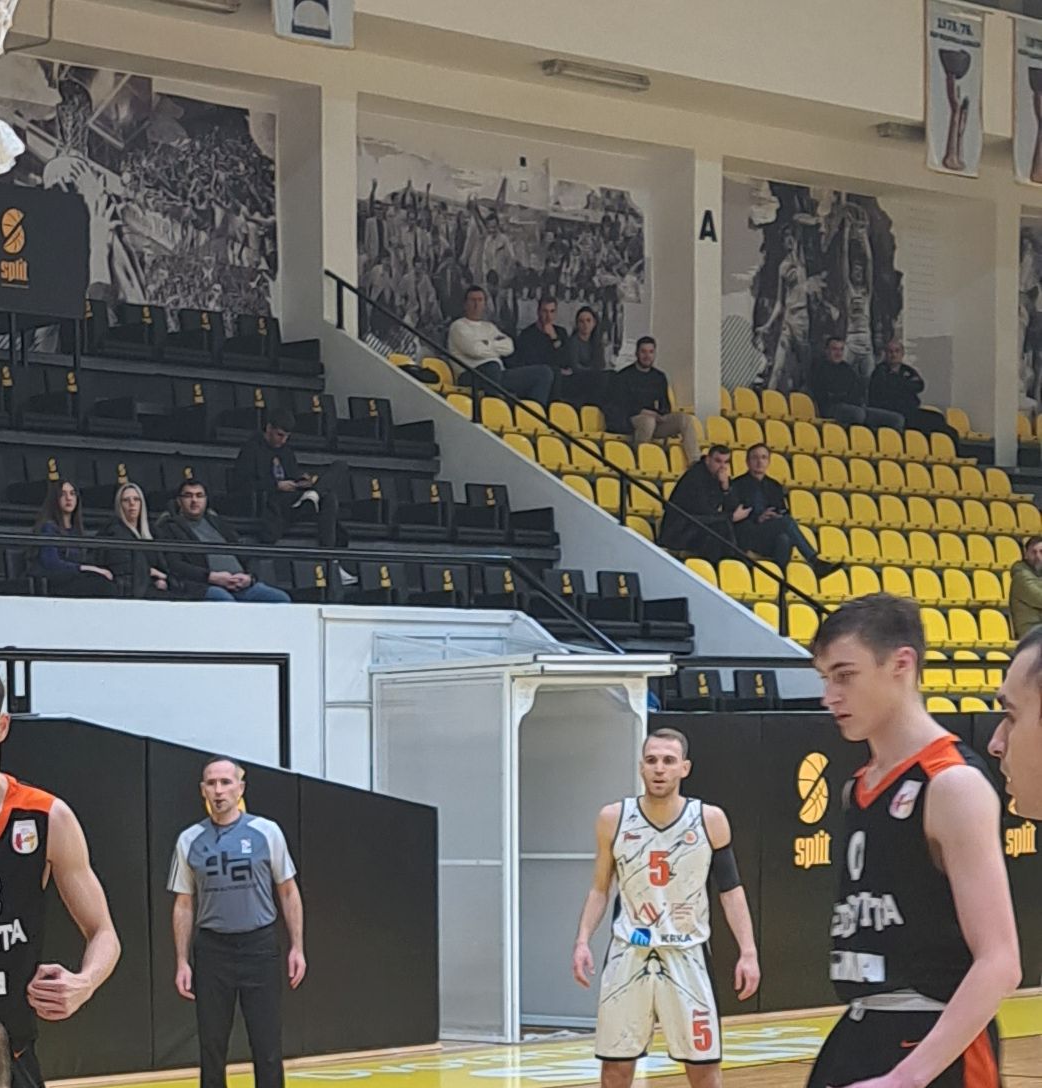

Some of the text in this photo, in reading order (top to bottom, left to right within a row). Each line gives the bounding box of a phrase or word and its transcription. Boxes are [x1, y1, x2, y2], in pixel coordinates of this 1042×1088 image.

[699, 209, 718, 242] A
[0, 257, 28, 282] split
[794, 829, 832, 869] split
[847, 830, 866, 881] 0
[1004, 821, 1037, 858] split
[649, 850, 671, 887] 5
[692, 1020, 713, 1051] 5
